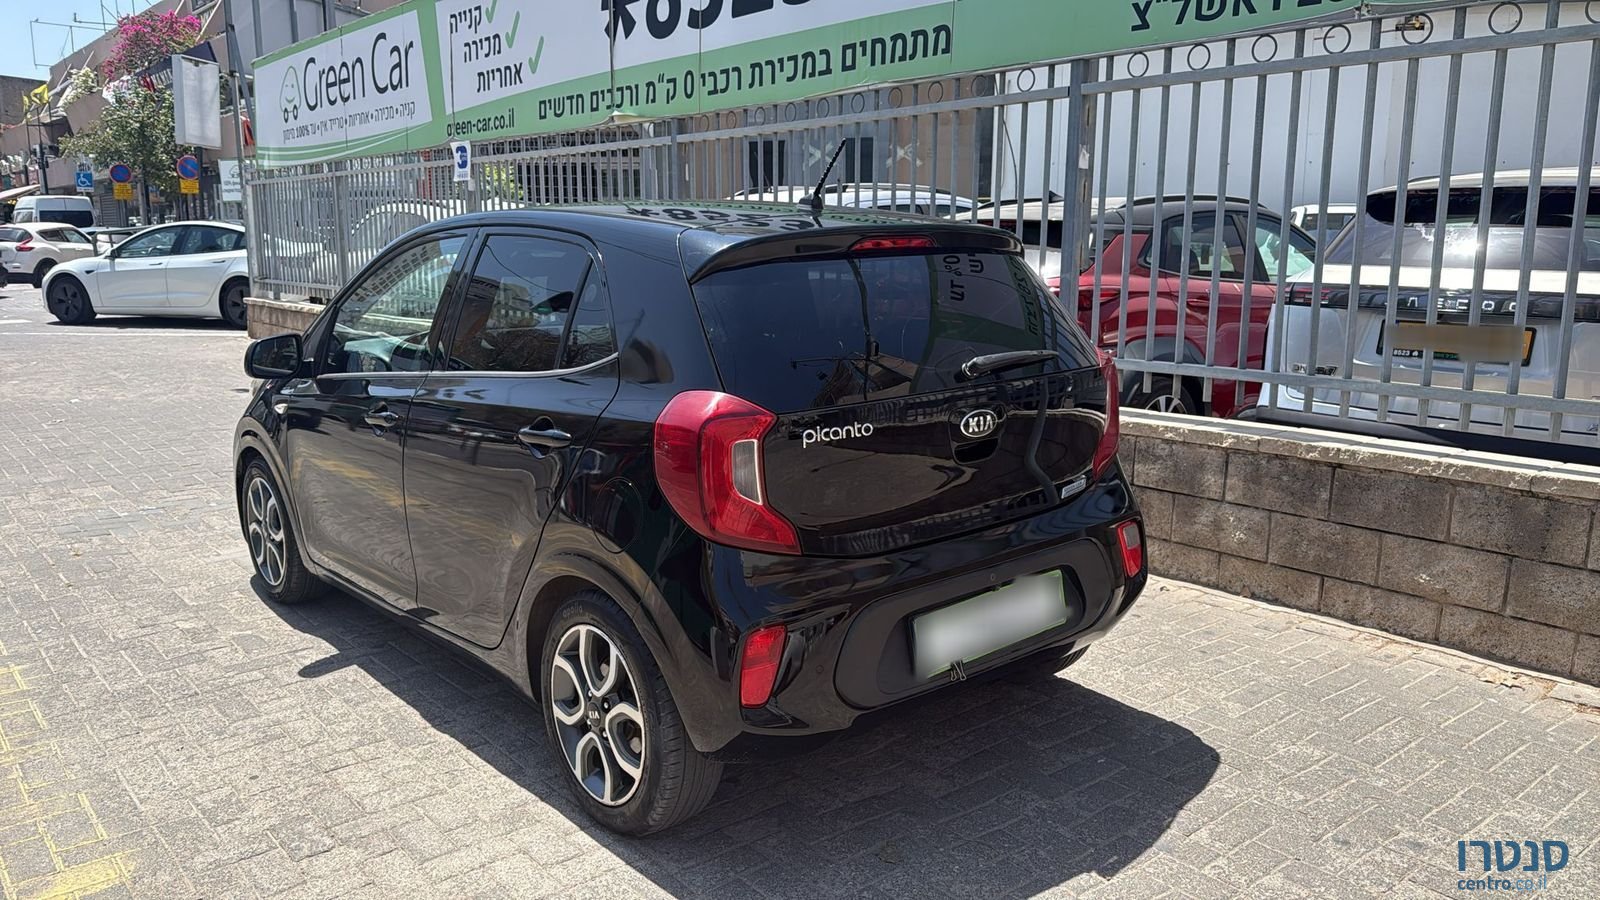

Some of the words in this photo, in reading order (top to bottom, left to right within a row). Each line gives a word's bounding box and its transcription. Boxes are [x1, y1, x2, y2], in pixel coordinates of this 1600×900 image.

[450, 5, 482, 34] קנייה
[1131, 0, 1281, 32] אשלצ
[464, 33, 502, 63] מכירה
[841, 24, 951, 72] מתמחים
[303, 57, 367, 112] Green
[371, 32, 414, 95] Car
[477, 62, 523, 93] אחריות
[700, 66, 742, 96] רכבי
[748, 48, 833, 89] במכירת
[590, 83, 640, 112] ורכבים
[683, 70, 695, 99] 0
[400, 101, 416, 120] קניה
[538, 93, 585, 120] חדשים
[447, 107, 515, 136] geen-car.co.il
[802, 421, 874, 448] picanto
[968, 414, 995, 433] KIA
